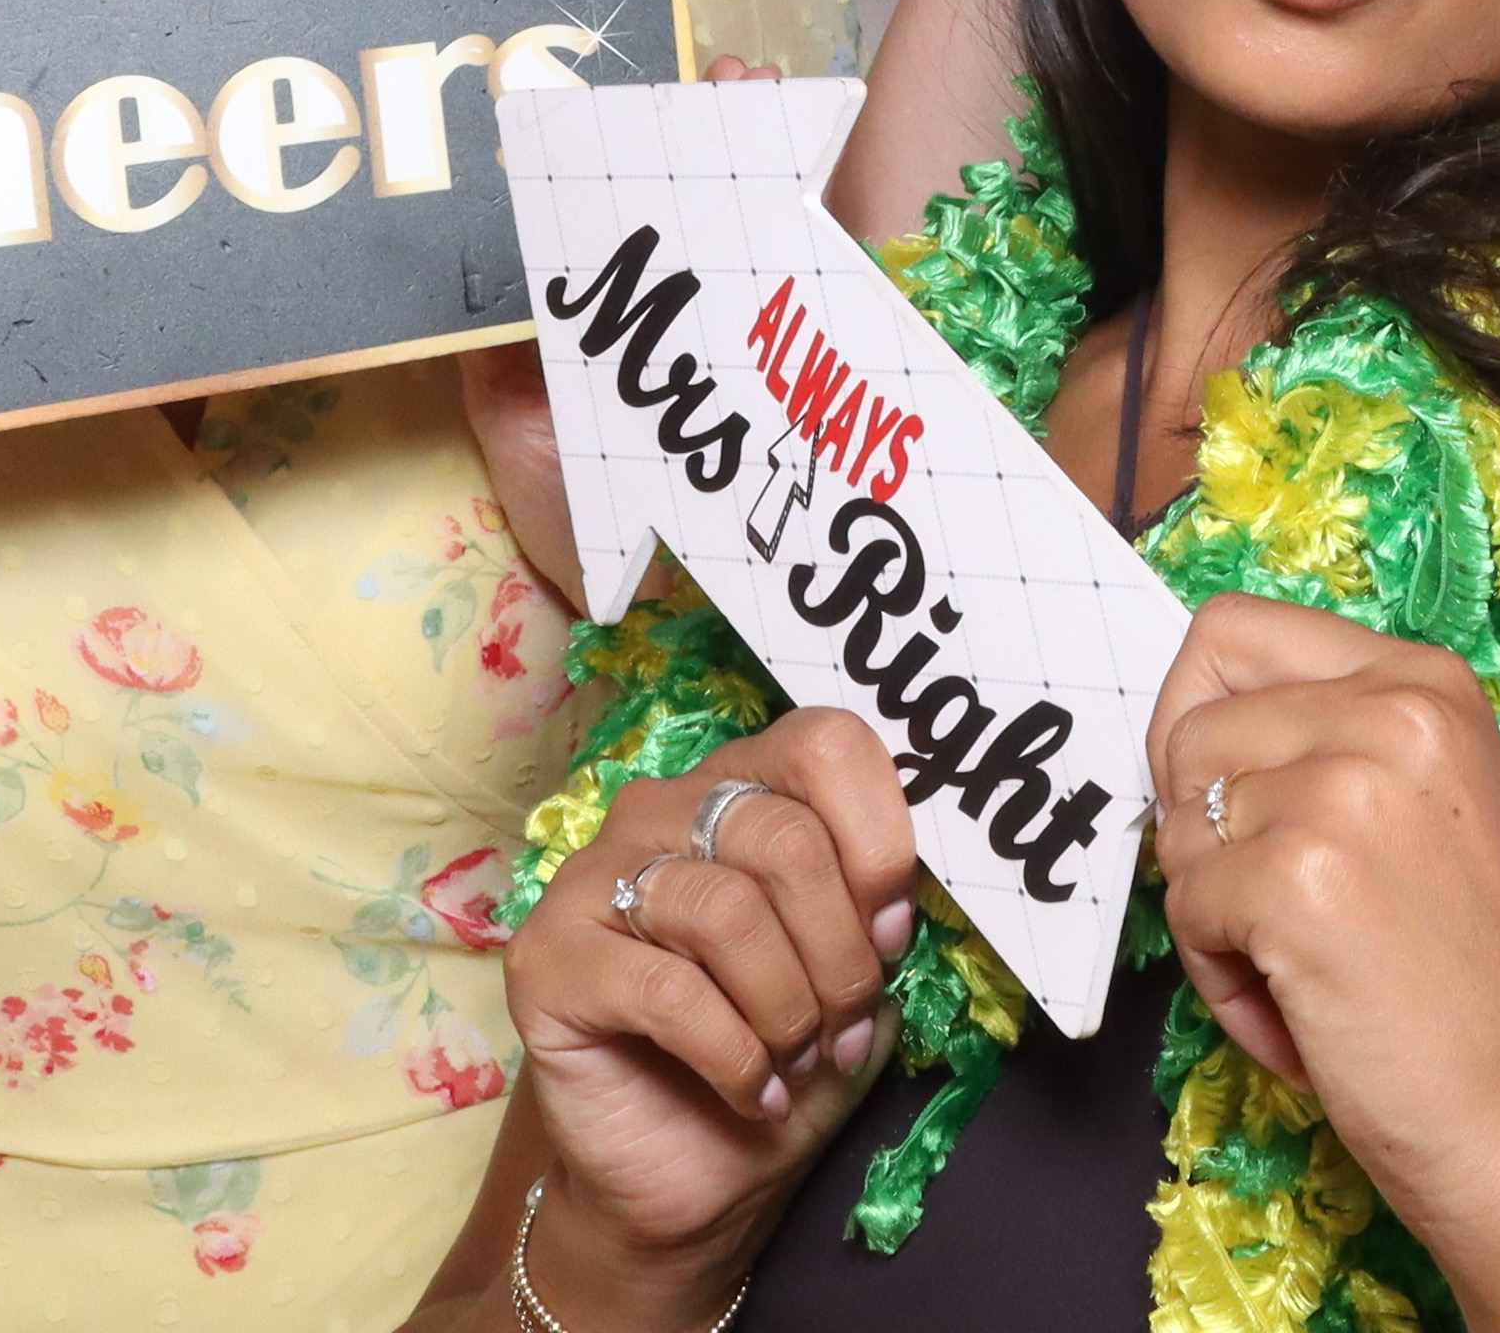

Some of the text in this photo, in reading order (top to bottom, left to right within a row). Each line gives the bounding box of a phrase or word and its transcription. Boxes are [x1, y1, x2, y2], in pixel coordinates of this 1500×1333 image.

[545, 225, 1112, 903] Mrs Right
[746, 275, 925, 505] ALWAYS
